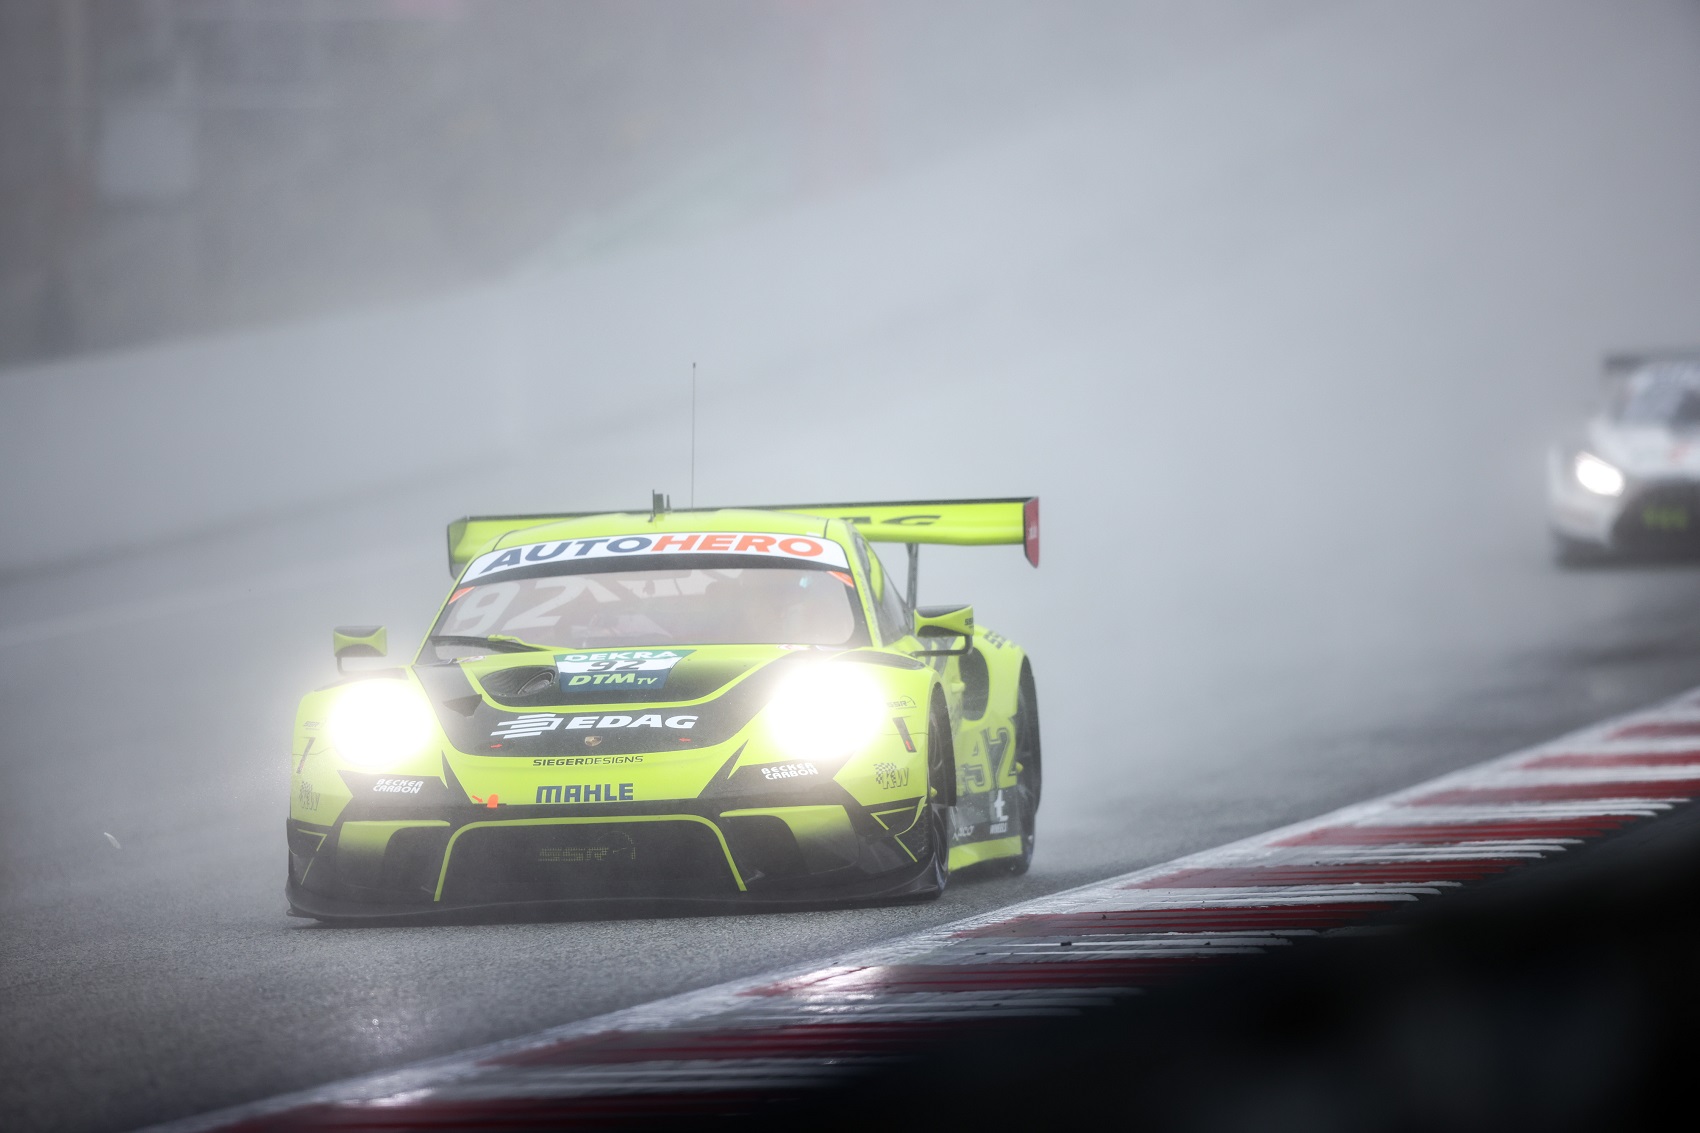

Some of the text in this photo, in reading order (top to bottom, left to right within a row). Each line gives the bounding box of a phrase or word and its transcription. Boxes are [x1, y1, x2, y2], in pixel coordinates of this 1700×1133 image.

[484, 533, 824, 573] AUTOHERO
[451, 577, 587, 637] 92
[563, 650, 678, 662] DEKRA
[587, 660, 646, 672] 92
[568, 673, 658, 686] DTM TV
[565, 714, 699, 730] EDAG
[533, 755, 644, 767] SIEGERDESIGNS
[760, 762, 815, 775] BECKER
[764, 768, 819, 780] CARBON
[376, 778, 424, 787] BECKER
[882, 767, 909, 790] KW
[373, 784, 421, 794] CARBON
[535, 782, 634, 804] MAHLE
